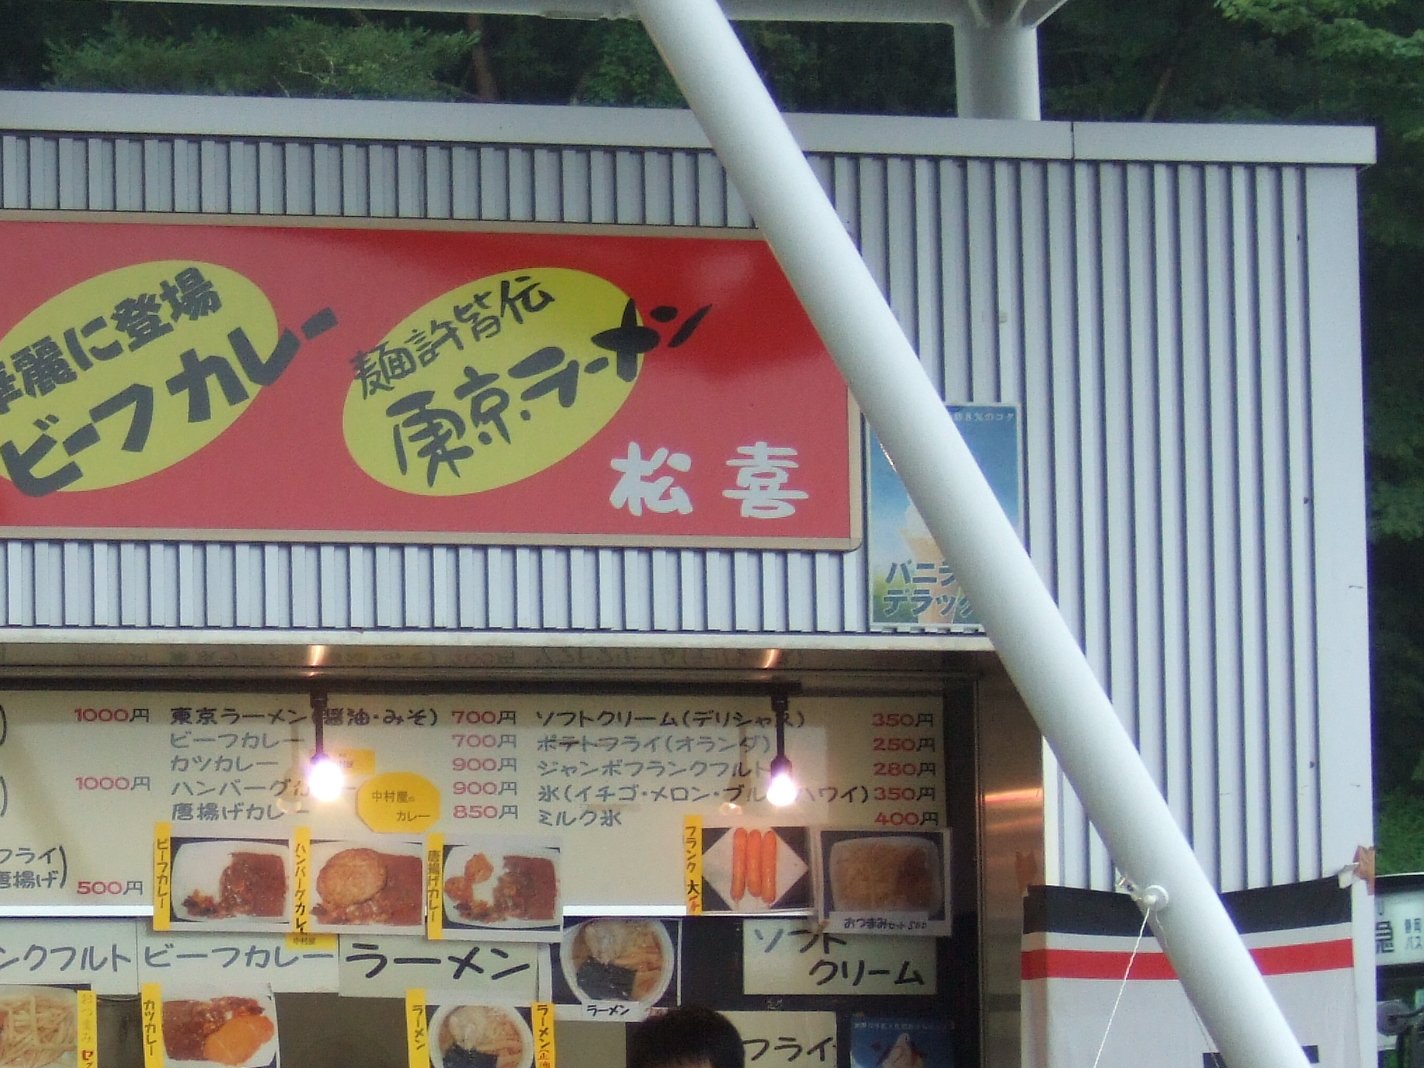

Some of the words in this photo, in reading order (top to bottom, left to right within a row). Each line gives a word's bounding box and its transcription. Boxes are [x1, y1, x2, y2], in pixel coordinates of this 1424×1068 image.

[0, 307, 338, 498] ビーフカレー
[386, 299, 714, 488] 東京ラーメン
[610, 441, 809, 520] 松喜
[74, 707, 150, 724] 1000円
[451, 709, 517, 726] 700円
[872, 712, 935, 729] 350円
[169, 731, 305, 750] ビーフカレー
[452, 733, 518, 749] 700円
[872, 737, 936, 753] 250円
[170, 755, 279, 773] カツカレー
[452, 757, 518, 774] 900円
[873, 762, 937, 778] 280円
[74, 775, 151, 792] 1000円
[452, 780, 519, 798] 900円
[873, 786, 936, 803] 350円
[171, 802, 310, 822] 唐揚げカレー
[452, 804, 519, 821] 850円
[396, 811, 431, 823] カレー
[537, 809, 622, 828] ミルク氷
[874, 811, 940, 828] 400円
[76, 880, 144, 897] 500円
[145, 938, 334, 970] ビーフカレー
[345, 943, 531, 980] ラーメン
[808, 959, 925, 987] クリーム
[586, 1004, 631, 1017] ラーメン
[143, 999, 157, 1056] カツカレー
[412, 1004, 426, 1050] ラーメン
